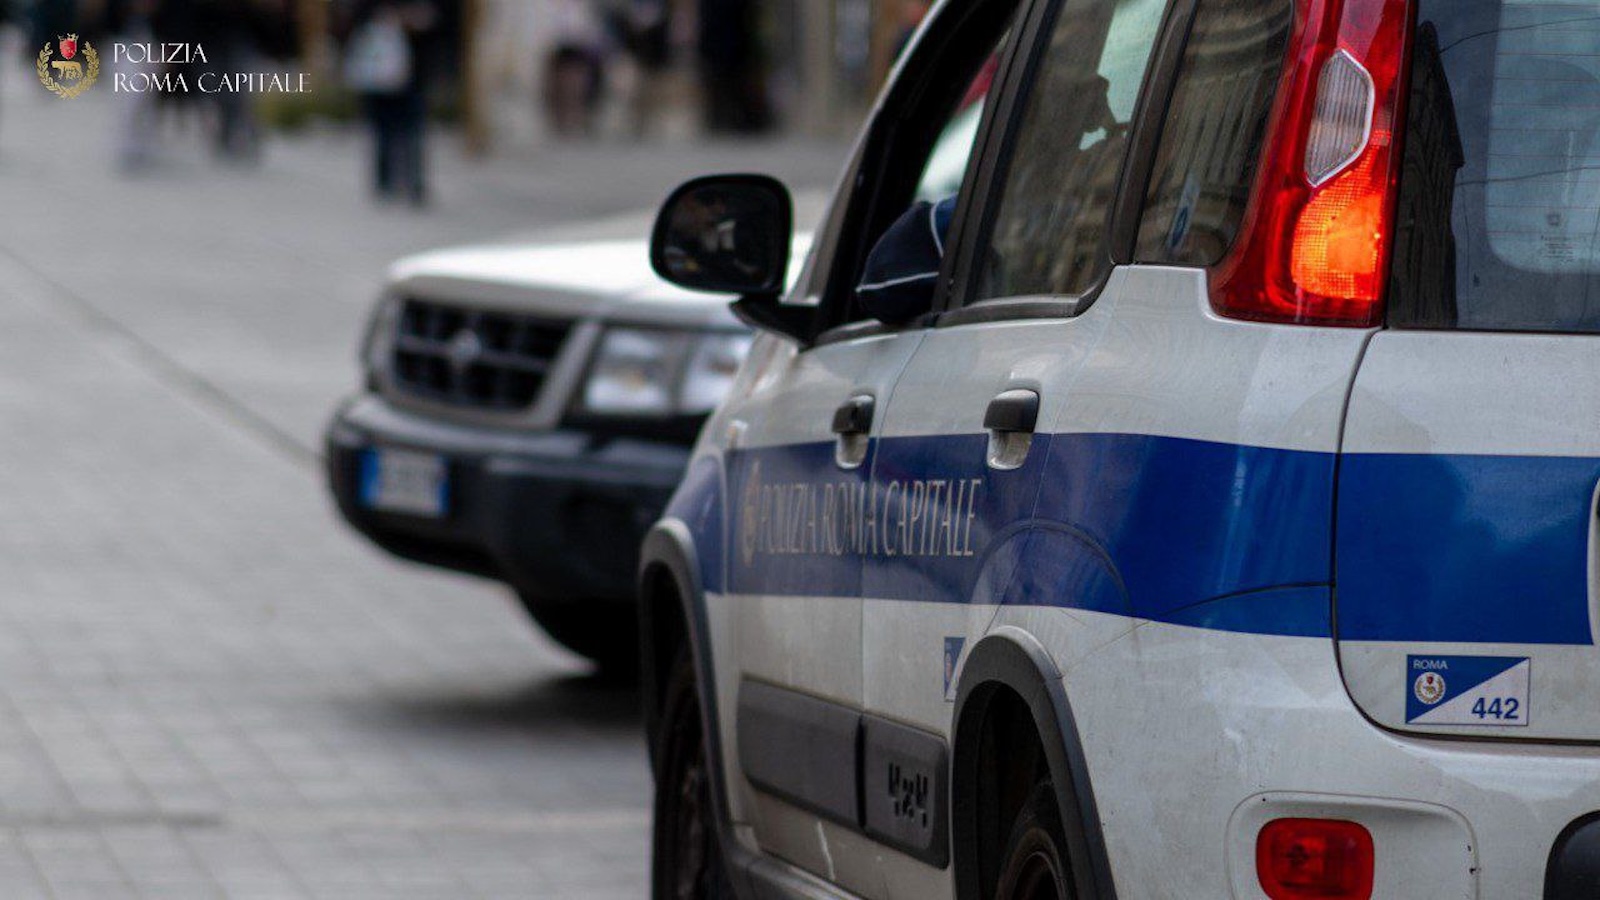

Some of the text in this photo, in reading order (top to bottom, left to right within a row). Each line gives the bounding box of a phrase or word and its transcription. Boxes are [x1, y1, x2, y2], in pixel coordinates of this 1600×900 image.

[761, 479, 982, 557] POLIZIA ROMA CAPITALE
[1413, 659, 1448, 670] ROMA
[1471, 696, 1519, 720] 442
